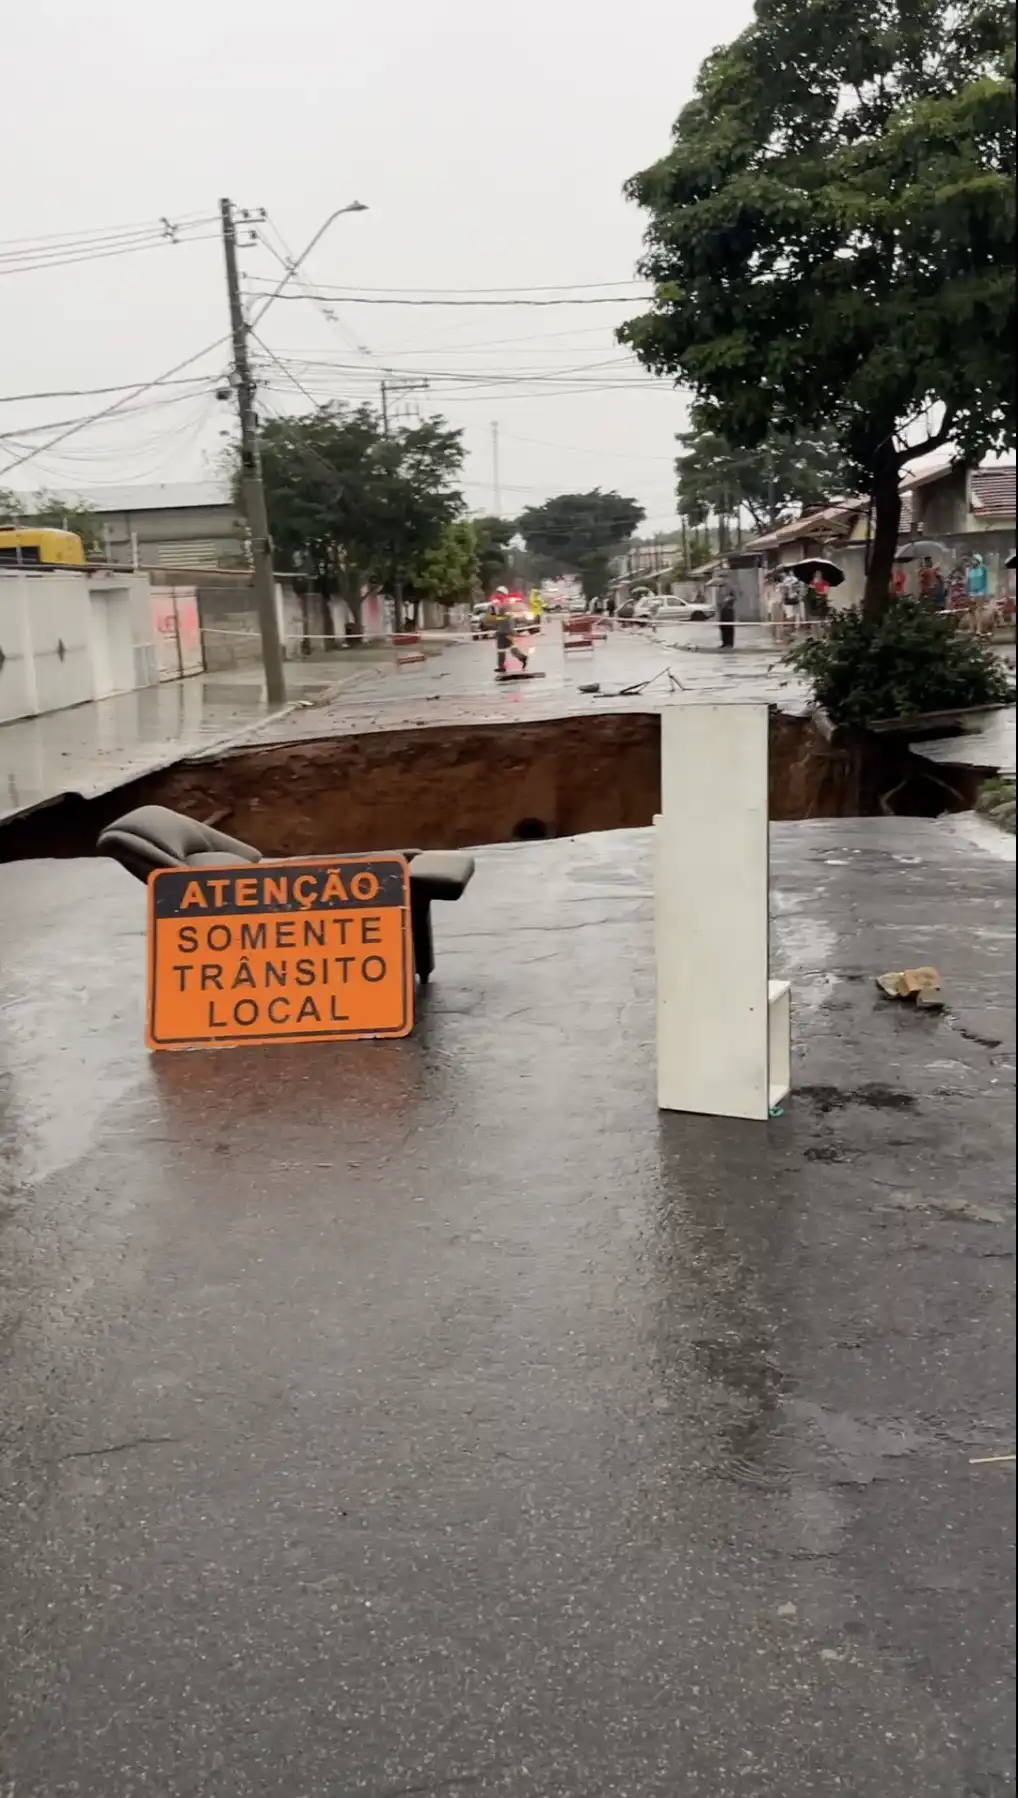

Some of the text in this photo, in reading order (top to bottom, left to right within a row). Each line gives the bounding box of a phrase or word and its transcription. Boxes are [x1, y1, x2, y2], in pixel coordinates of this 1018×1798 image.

[180, 868, 379, 910] ATENÇÃO
[177, 916, 382, 953] SOMENTE
[172, 955, 386, 992] TRÂNSITO
[208, 995, 349, 1028] LOCAL
